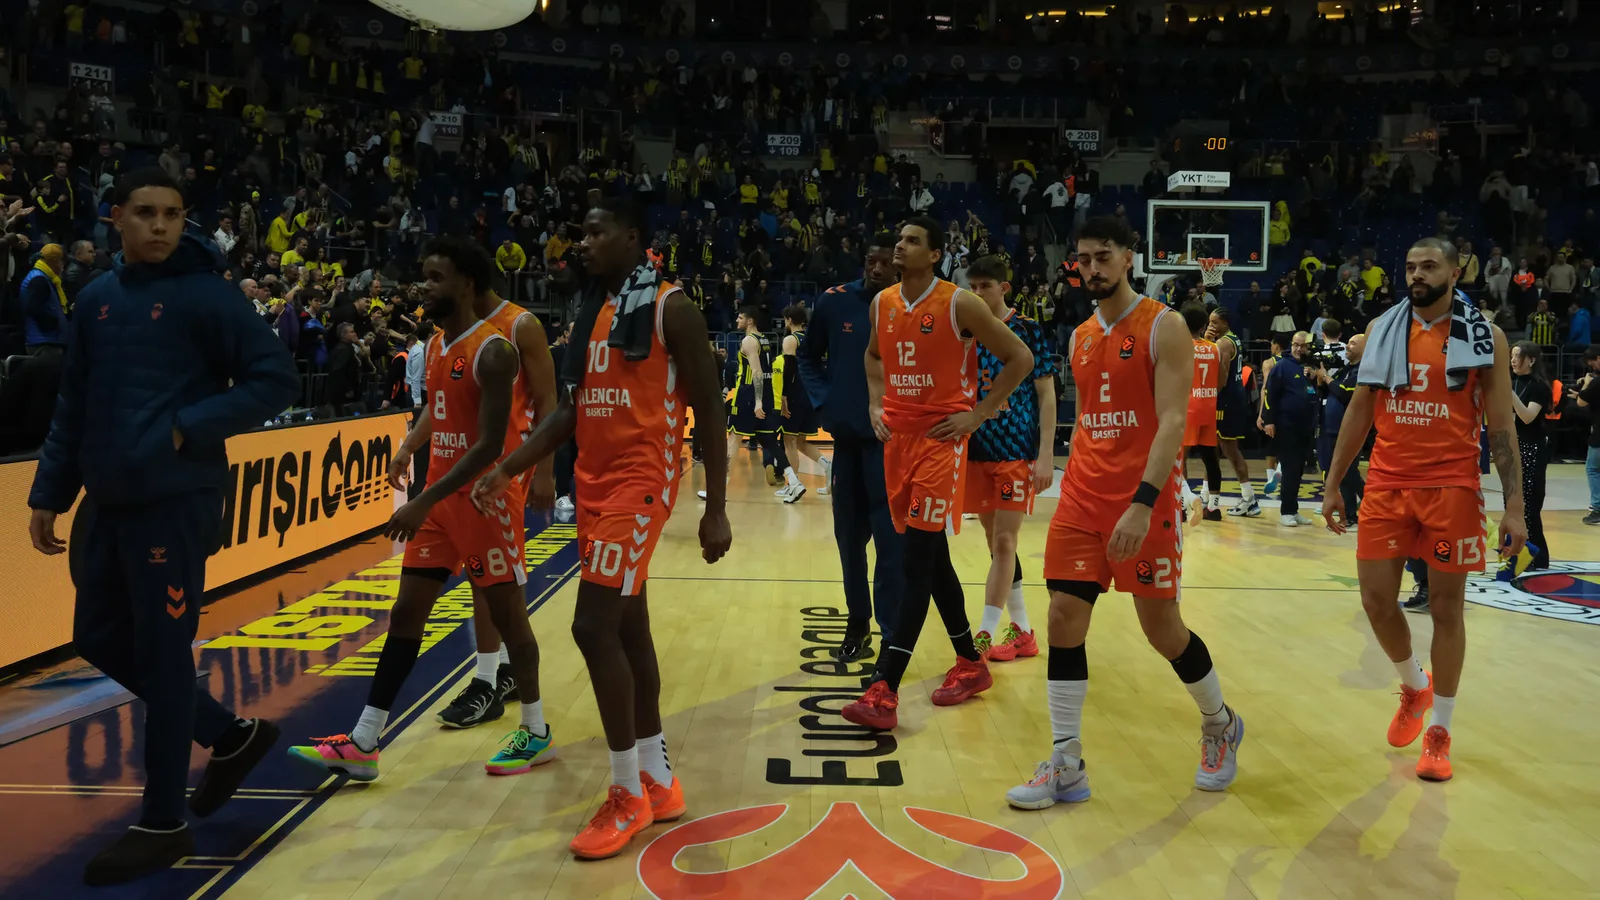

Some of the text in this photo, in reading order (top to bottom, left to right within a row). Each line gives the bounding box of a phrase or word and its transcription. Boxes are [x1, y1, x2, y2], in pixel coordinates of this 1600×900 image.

[85, 67, 108, 79] 211
[85, 80, 108, 92] 11
[780, 136, 799, 144] 209
[1077, 131, 1097, 140] 208
[780, 146, 799, 155] 109
[1077, 142, 1097, 150] 108
[1181, 174, 1202, 183] YKT
[588, 340, 609, 374] 10
[896, 341, 917, 367] 12
[889, 374, 935, 387] VALENCIA
[1199, 363, 1209, 385] 7
[897, 388, 922, 397] BASKET
[1100, 372, 1111, 403] 2
[434, 390, 447, 420] 8
[579, 388, 632, 408] ALENCIA
[585, 408, 614, 417] BASKET
[1385, 398, 1450, 419] VALENCIA
[1395, 416, 1432, 426] BASKET
[432, 432, 468, 449] ENCIA
[1092, 429, 1121, 439] BASKET
[1013, 480, 1025, 502] 5
[923, 496, 946, 523] 12
[590, 540, 623, 576] 10
[1456, 536, 1480, 565] 13
[487, 548, 508, 576] 8
[1155, 558, 1173, 588] 2
